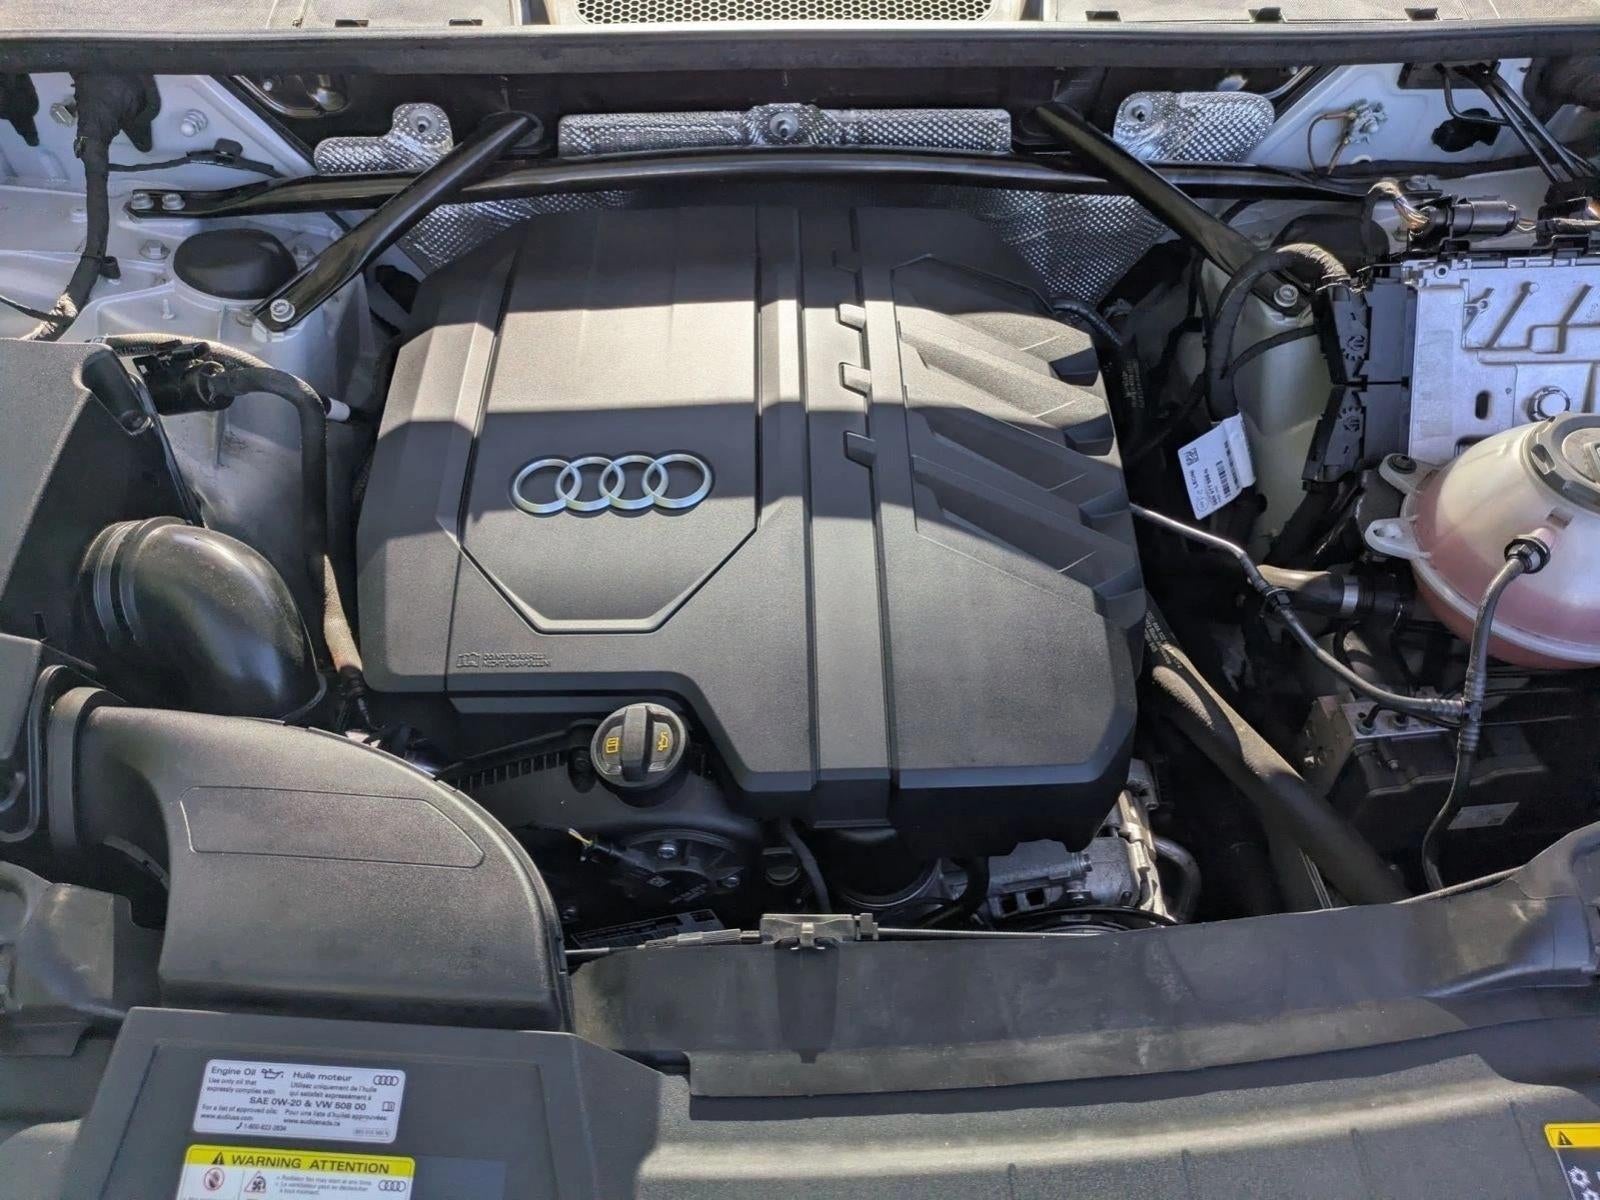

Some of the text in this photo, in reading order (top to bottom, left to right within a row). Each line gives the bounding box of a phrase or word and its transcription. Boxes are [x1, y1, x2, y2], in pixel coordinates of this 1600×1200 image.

[212, 1066, 256, 1076] Engine Oil
[293, 1071, 352, 1081] Huile moteur
[250, 1096, 270, 1104] SAE
[271, 1098, 302, 1106] 0W-20
[316, 1100, 332, 1108] VW
[334, 1102, 352, 1110] 508
[232, 1154, 390, 1174] WARNING ATTENTION
